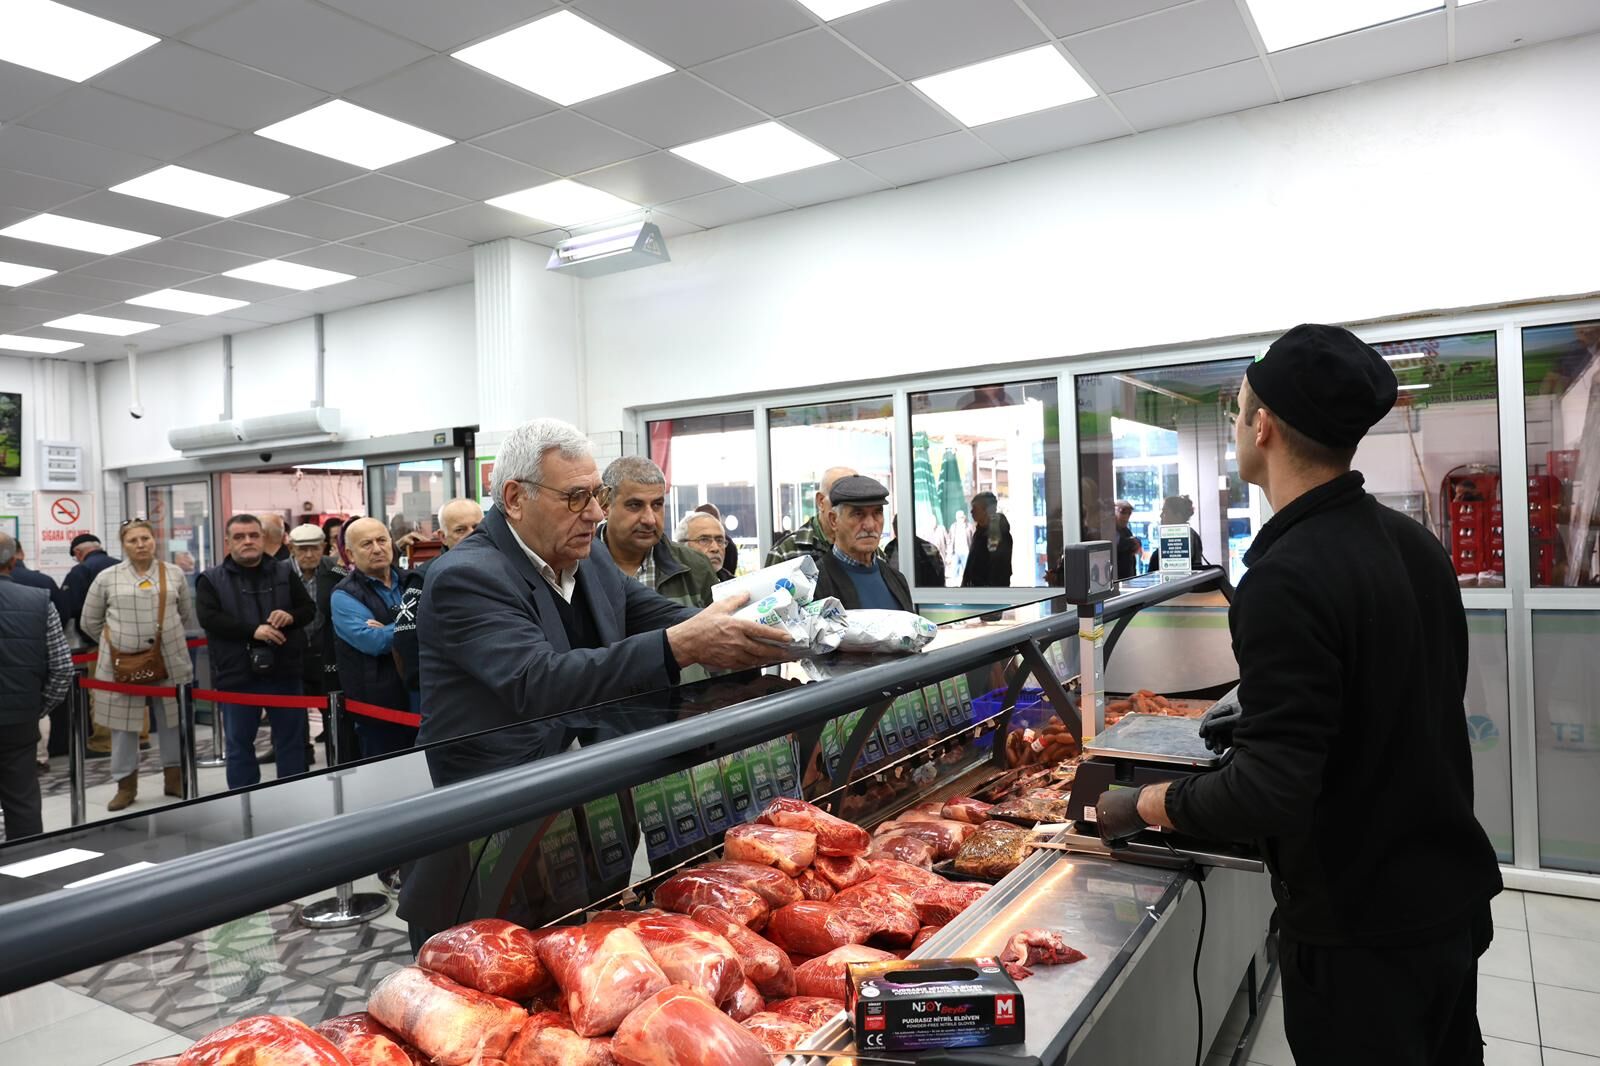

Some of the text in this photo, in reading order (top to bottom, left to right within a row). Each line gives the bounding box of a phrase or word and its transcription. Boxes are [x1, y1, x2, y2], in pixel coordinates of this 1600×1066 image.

[997, 999, 1013, 1015] M
[954, 1014, 980, 1022] ELDİVEN
[867, 1033, 884, 1046] CE
